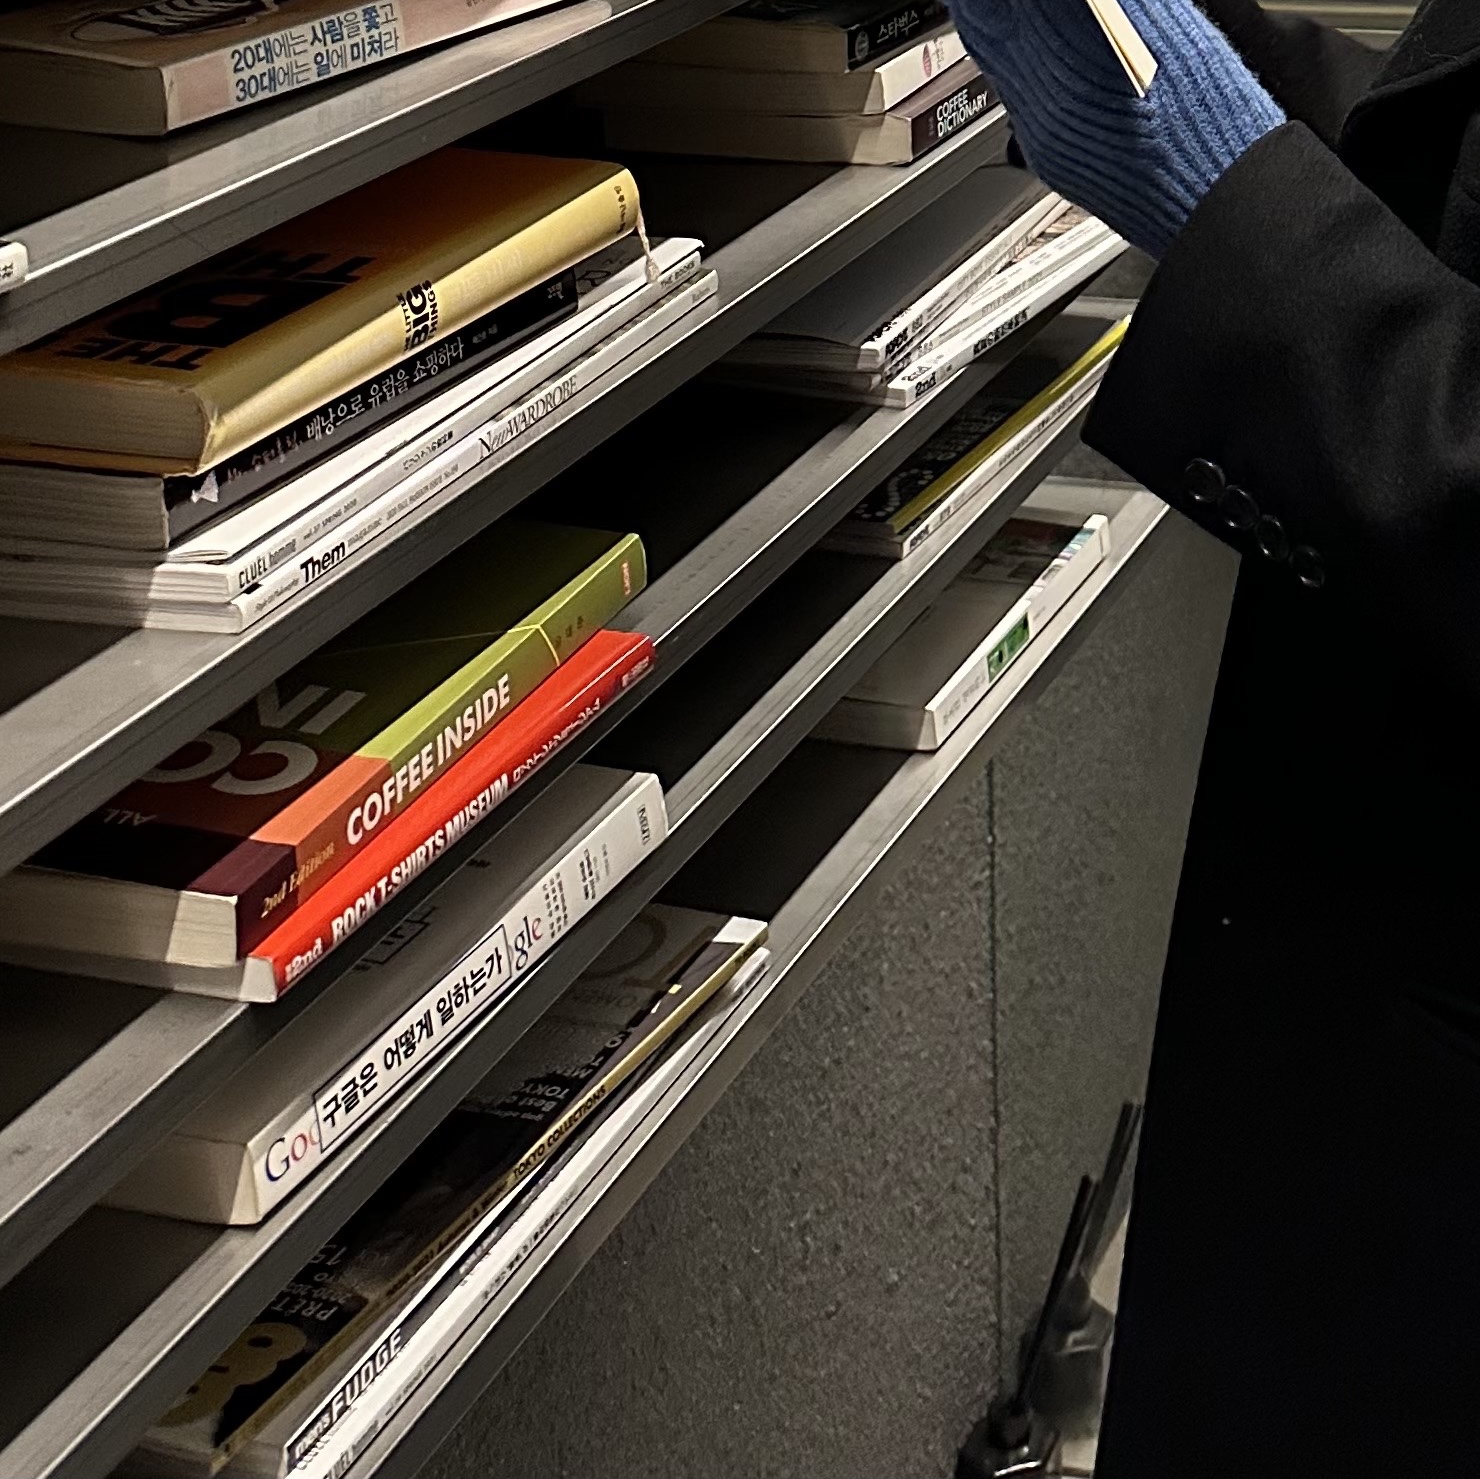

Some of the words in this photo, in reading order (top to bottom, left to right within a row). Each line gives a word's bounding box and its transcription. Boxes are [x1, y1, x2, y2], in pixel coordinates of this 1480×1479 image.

[231, 30, 309, 75] 20대에는
[310, 10, 361, 48] 사람을
[235, 58, 311, 103] 30대에는
[312, 42, 348, 78] 일에
[350, 26, 400, 63] 미쳐라
[935, 86, 970, 122] COFFEE
[936, 90, 990, 138] DICTIONARY
[405, 283, 431, 349] BIG
[305, 394, 366, 442] 배낭으로
[367, 367, 411, 410] 유럽을
[411, 335, 465, 388] 쇼핑하다
[299, 540, 346, 583] Them
[345, 748, 435, 846] COFFEE
[434, 673, 512, 769] INSIDE
[260, 880, 288, 918] 2nd
[288, 839, 337, 888] Edition
[330, 885, 379, 940] ROCK
[375, 827, 446, 908] T-SHIRTS
[443, 772, 511, 842] MUSEUM
[320, 1064, 379, 1126] 구글은
[382, 1008, 435, 1069] 어떻게
[434, 945, 504, 1022] 일하는가
[545, 1084, 609, 1149] COLLECTIONS
[328, 1332, 404, 1416] FUDGE
